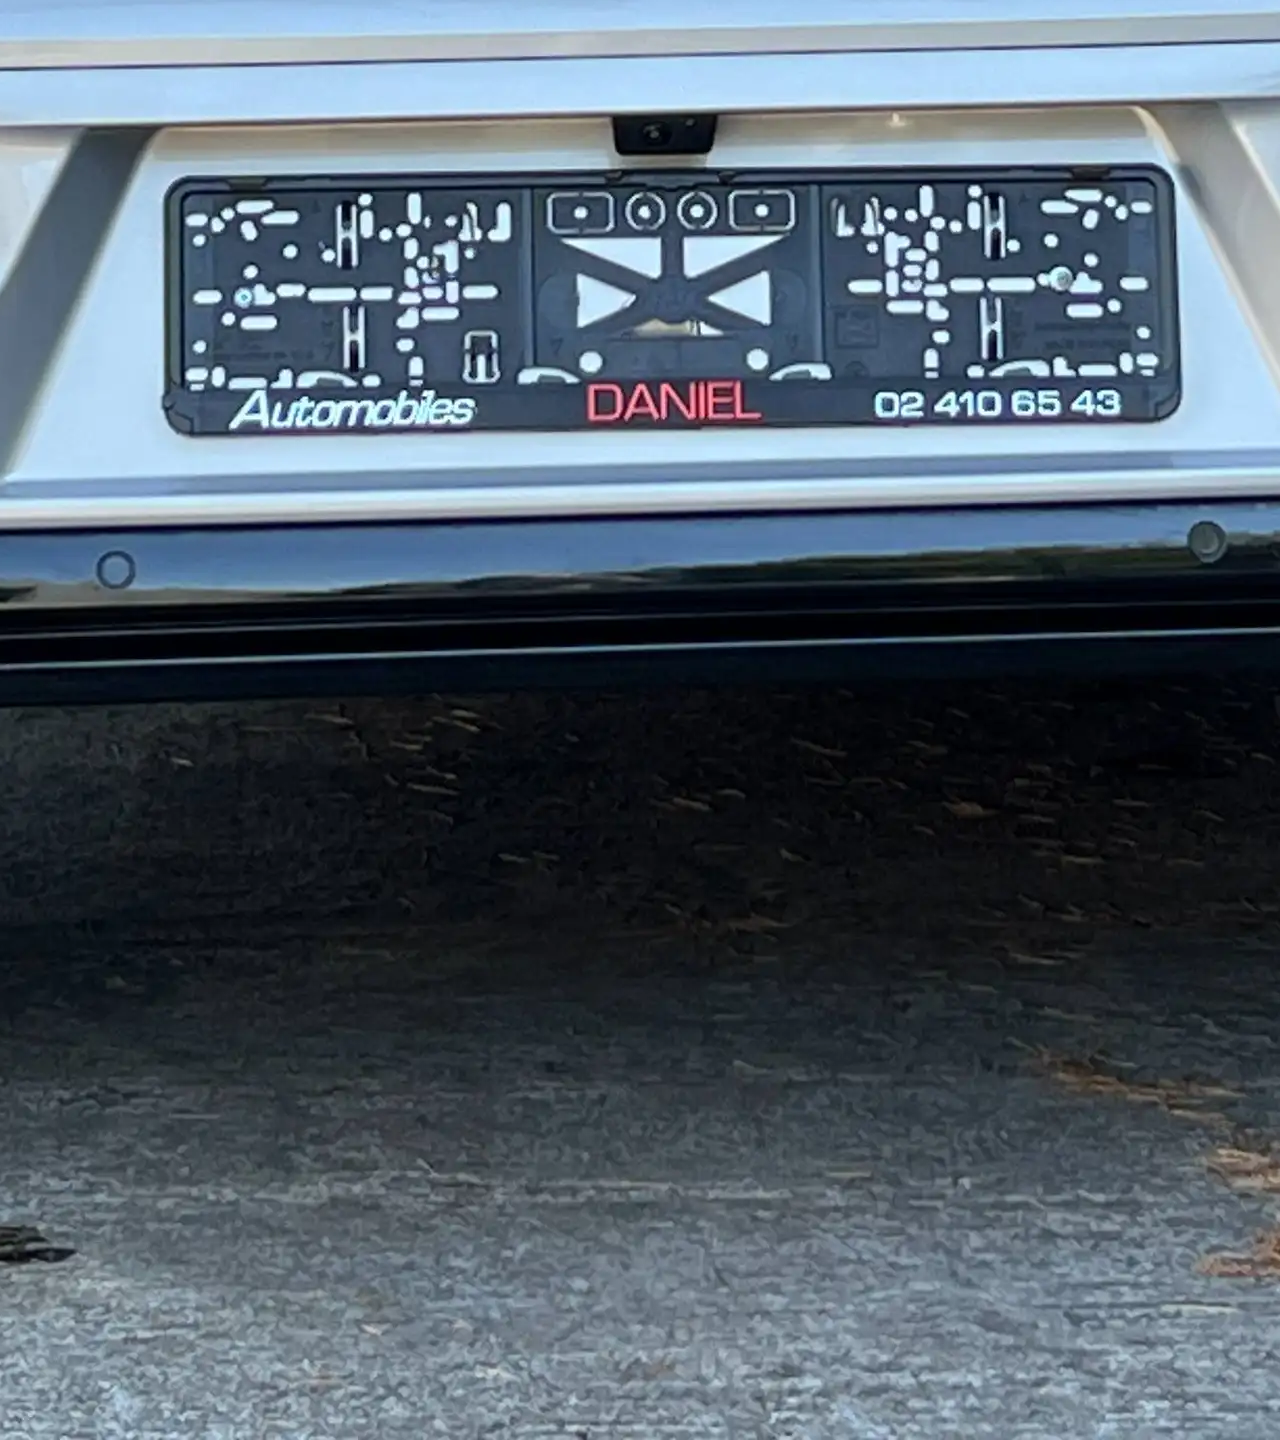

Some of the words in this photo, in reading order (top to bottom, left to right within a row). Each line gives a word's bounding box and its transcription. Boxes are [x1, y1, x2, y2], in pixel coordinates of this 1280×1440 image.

[229, 390, 478, 430] Automobiles
[587, 380, 762, 422] DANIEL
[874, 391, 925, 418] 02
[933, 391, 1002, 418] 410
[1011, 390, 1061, 417] 65
[1071, 390, 1121, 417] 43
